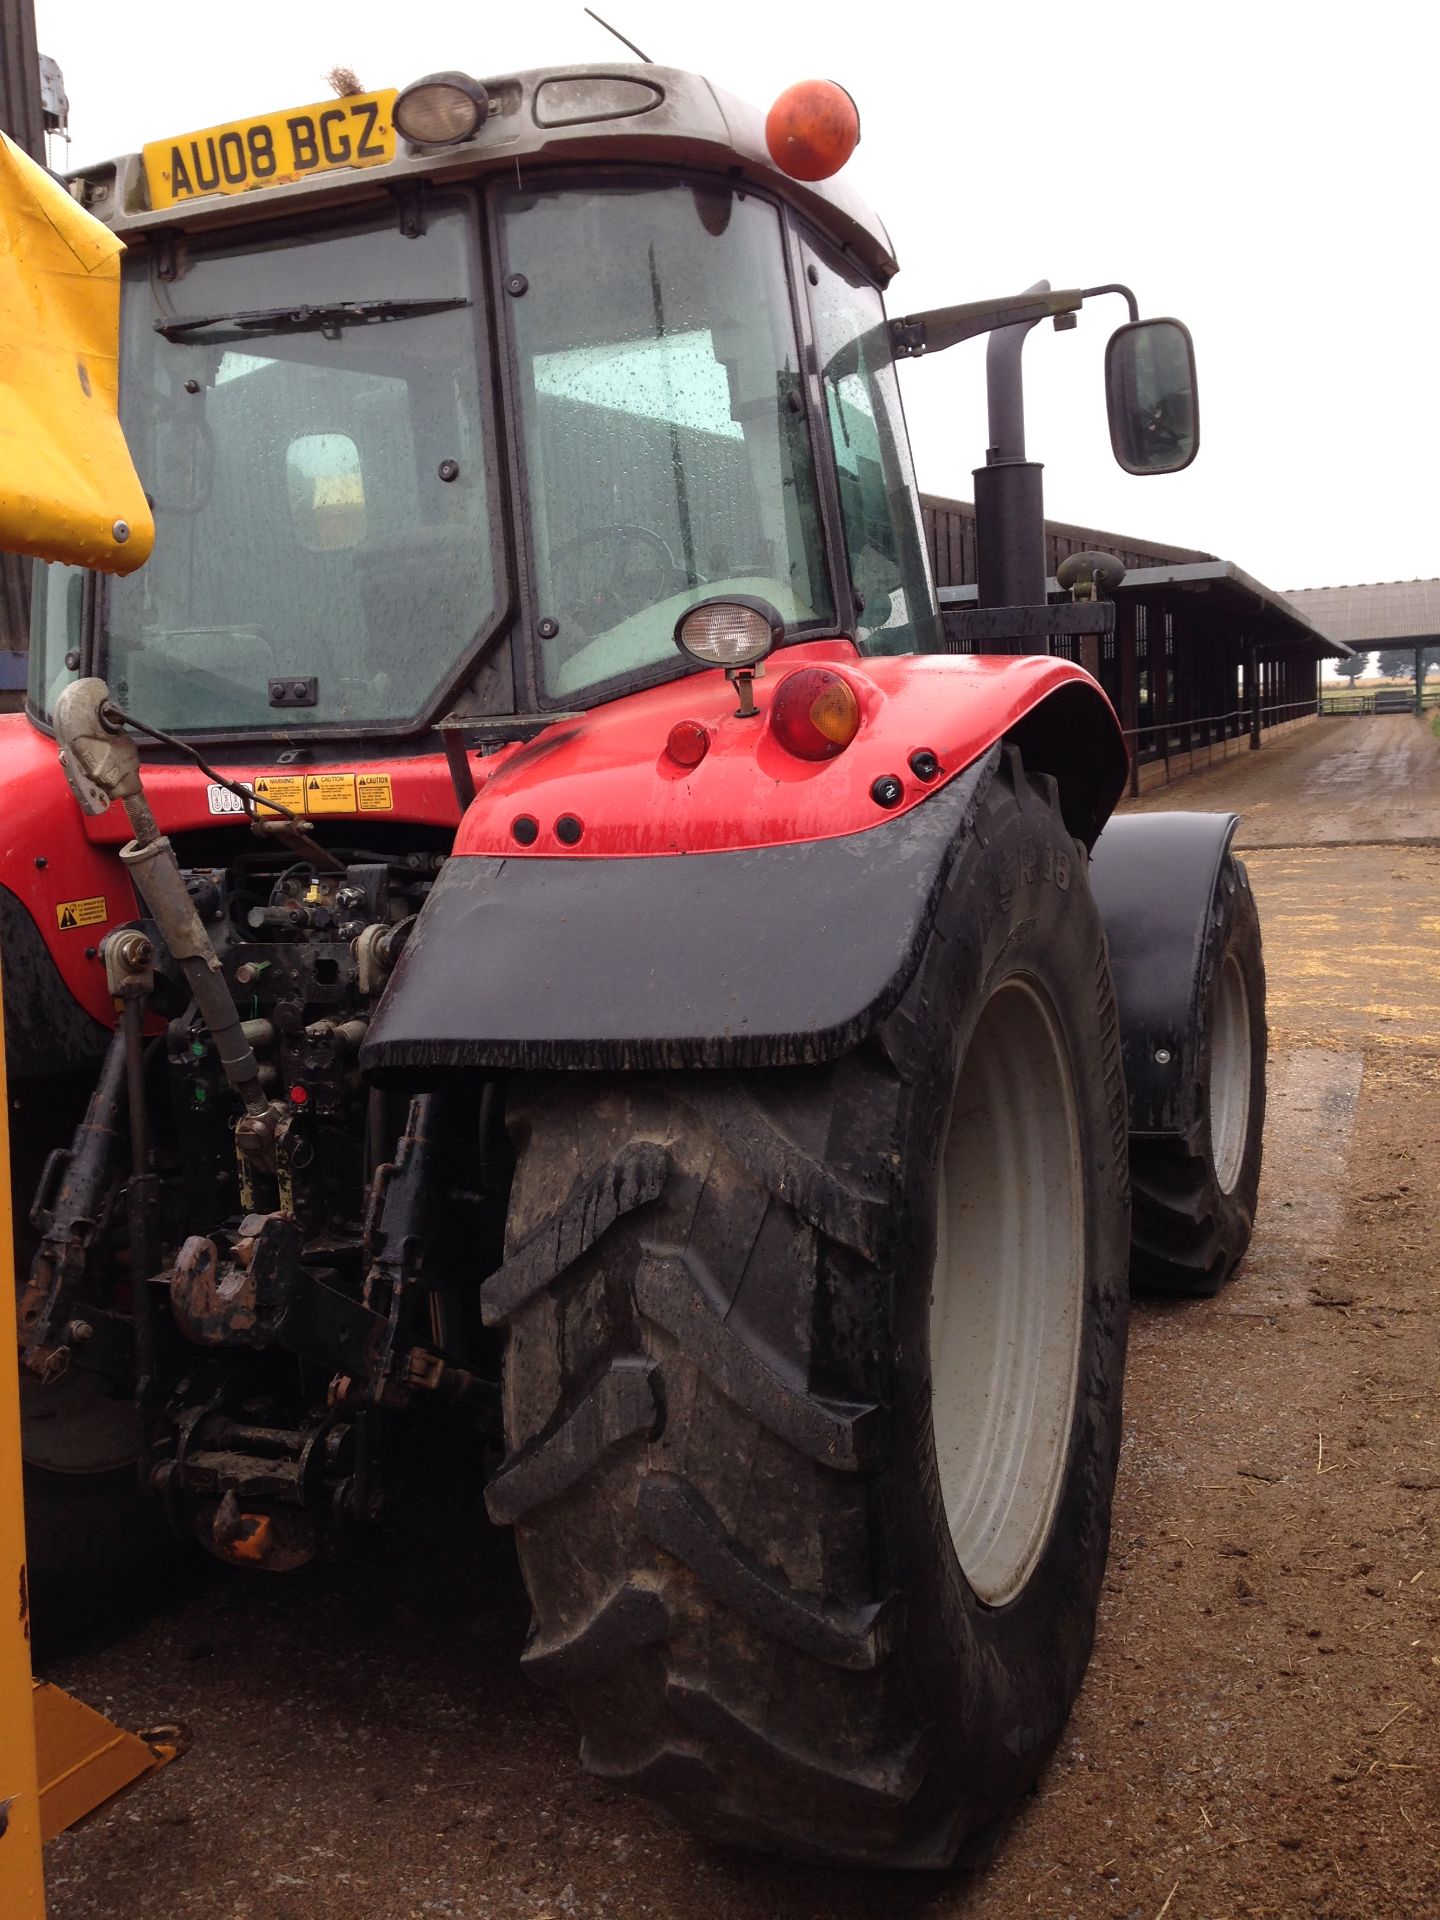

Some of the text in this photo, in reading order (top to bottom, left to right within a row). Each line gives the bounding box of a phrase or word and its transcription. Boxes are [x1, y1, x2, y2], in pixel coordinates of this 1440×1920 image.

[171, 101, 385, 198] AU08 BGZ
[321, 775, 345, 783] CAUTION
[366, 776, 389, 784] CAUTION
